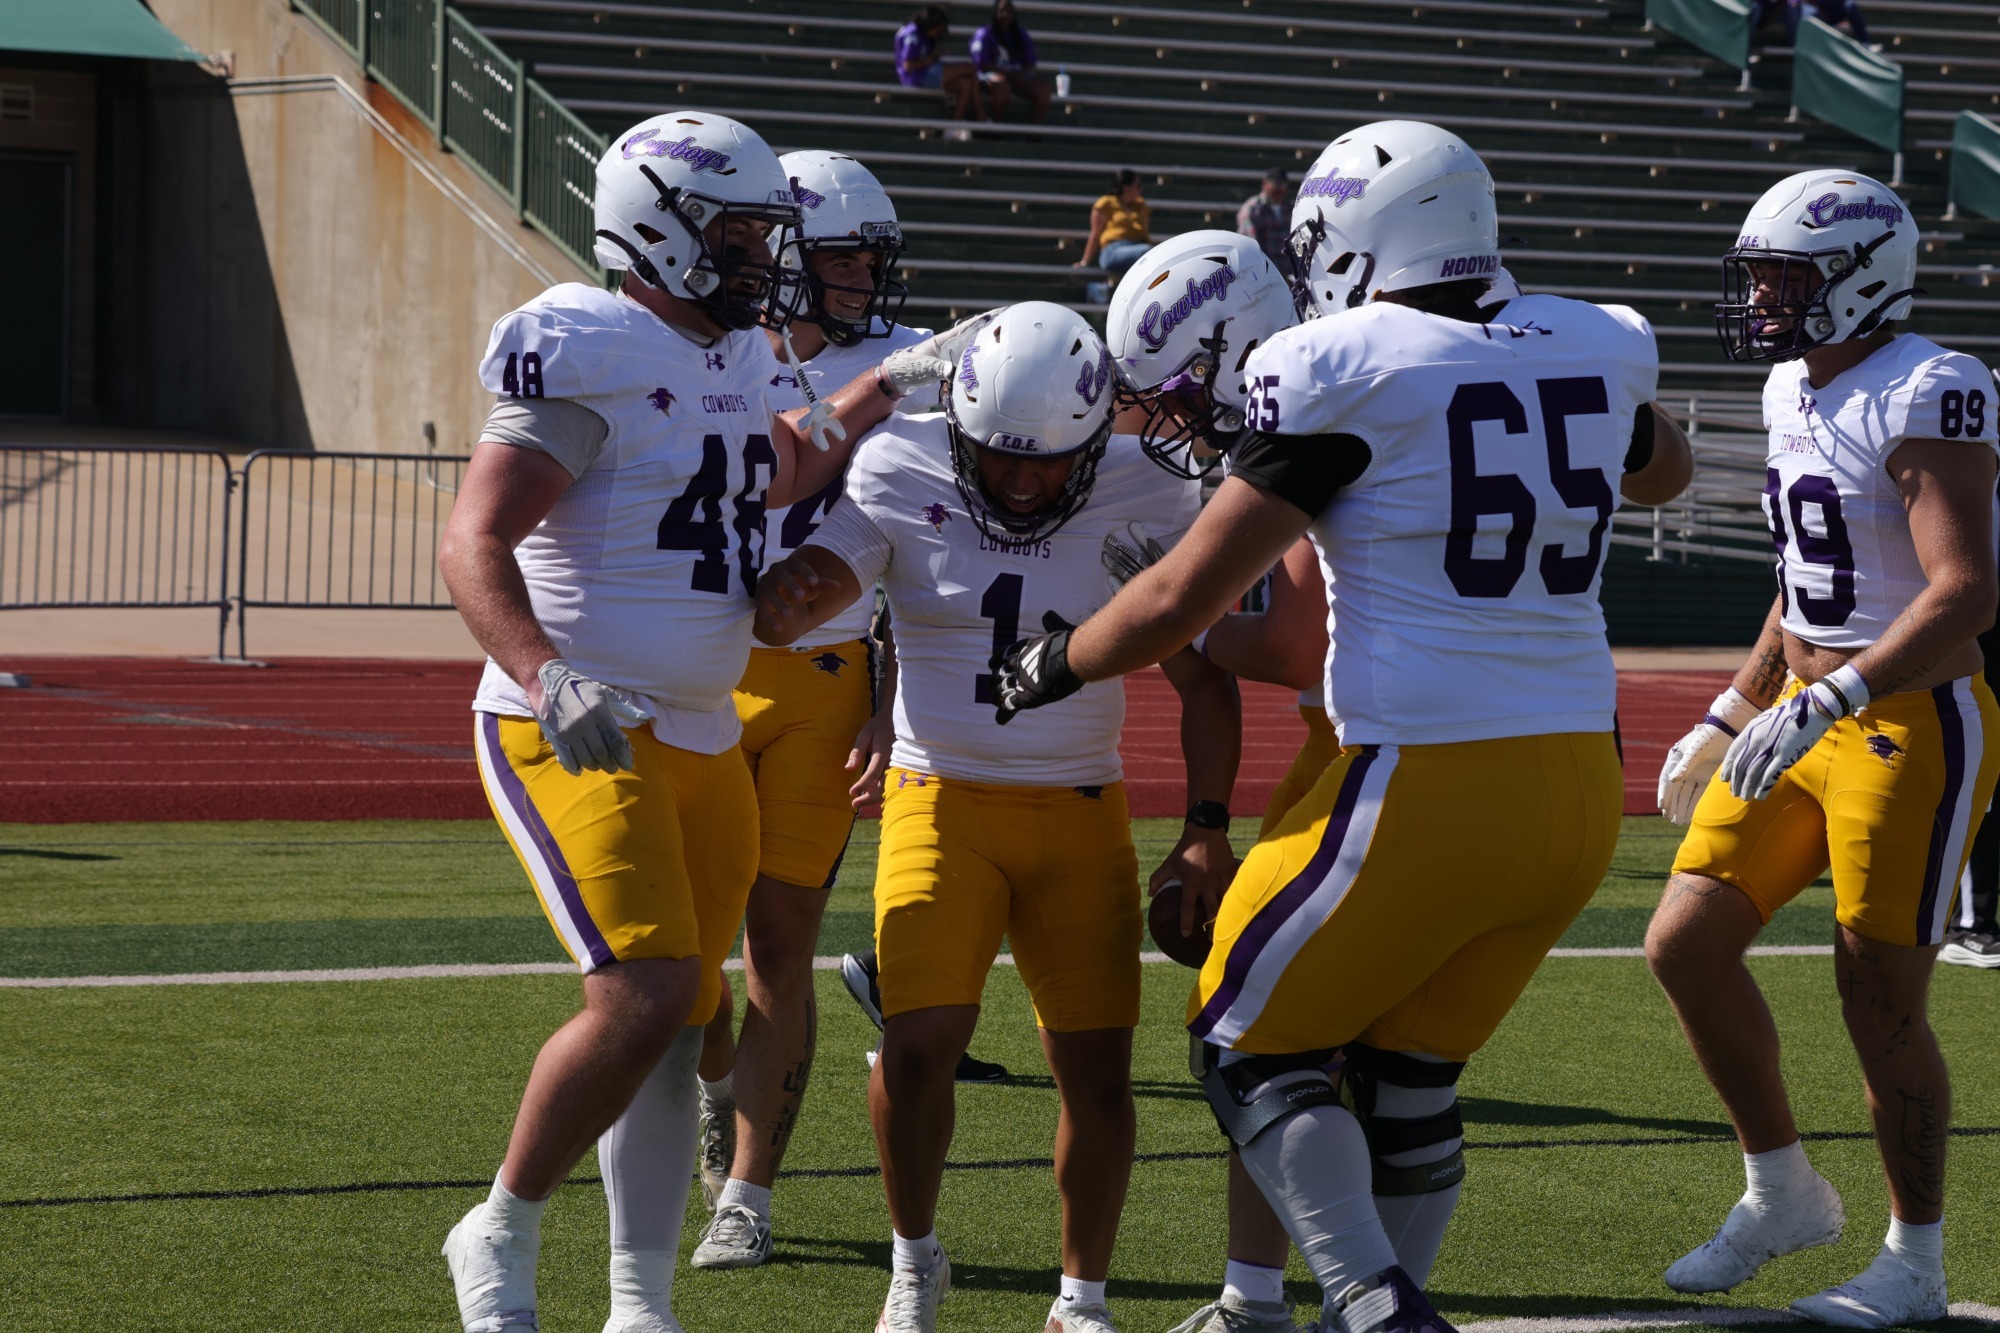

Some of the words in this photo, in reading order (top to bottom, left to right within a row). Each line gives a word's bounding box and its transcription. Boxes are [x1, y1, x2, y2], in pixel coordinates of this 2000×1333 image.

[623, 128, 731, 172] Cowboys
[1806, 192, 1903, 228] Cowboys
[1440, 256, 1497, 277] HOOYAH
[1137, 264, 1235, 348] Cowboys
[502, 352, 544, 399] 48
[797, 368, 818, 404] NXTRND
[702, 394, 748, 414] COWBOYS
[1247, 375, 1280, 433] 65
[1940, 390, 1986, 438] 89
[1001, 434, 1038, 452] T.D.E.
[1780, 434, 1816, 455] COWBOYS
[1444, 376, 1613, 598] 65
[656, 434, 778, 598] 48
[975, 572, 1024, 704] 1
[1286, 1084, 1331, 1102] DONJOY
[1431, 1159, 1463, 1181] DONJO
